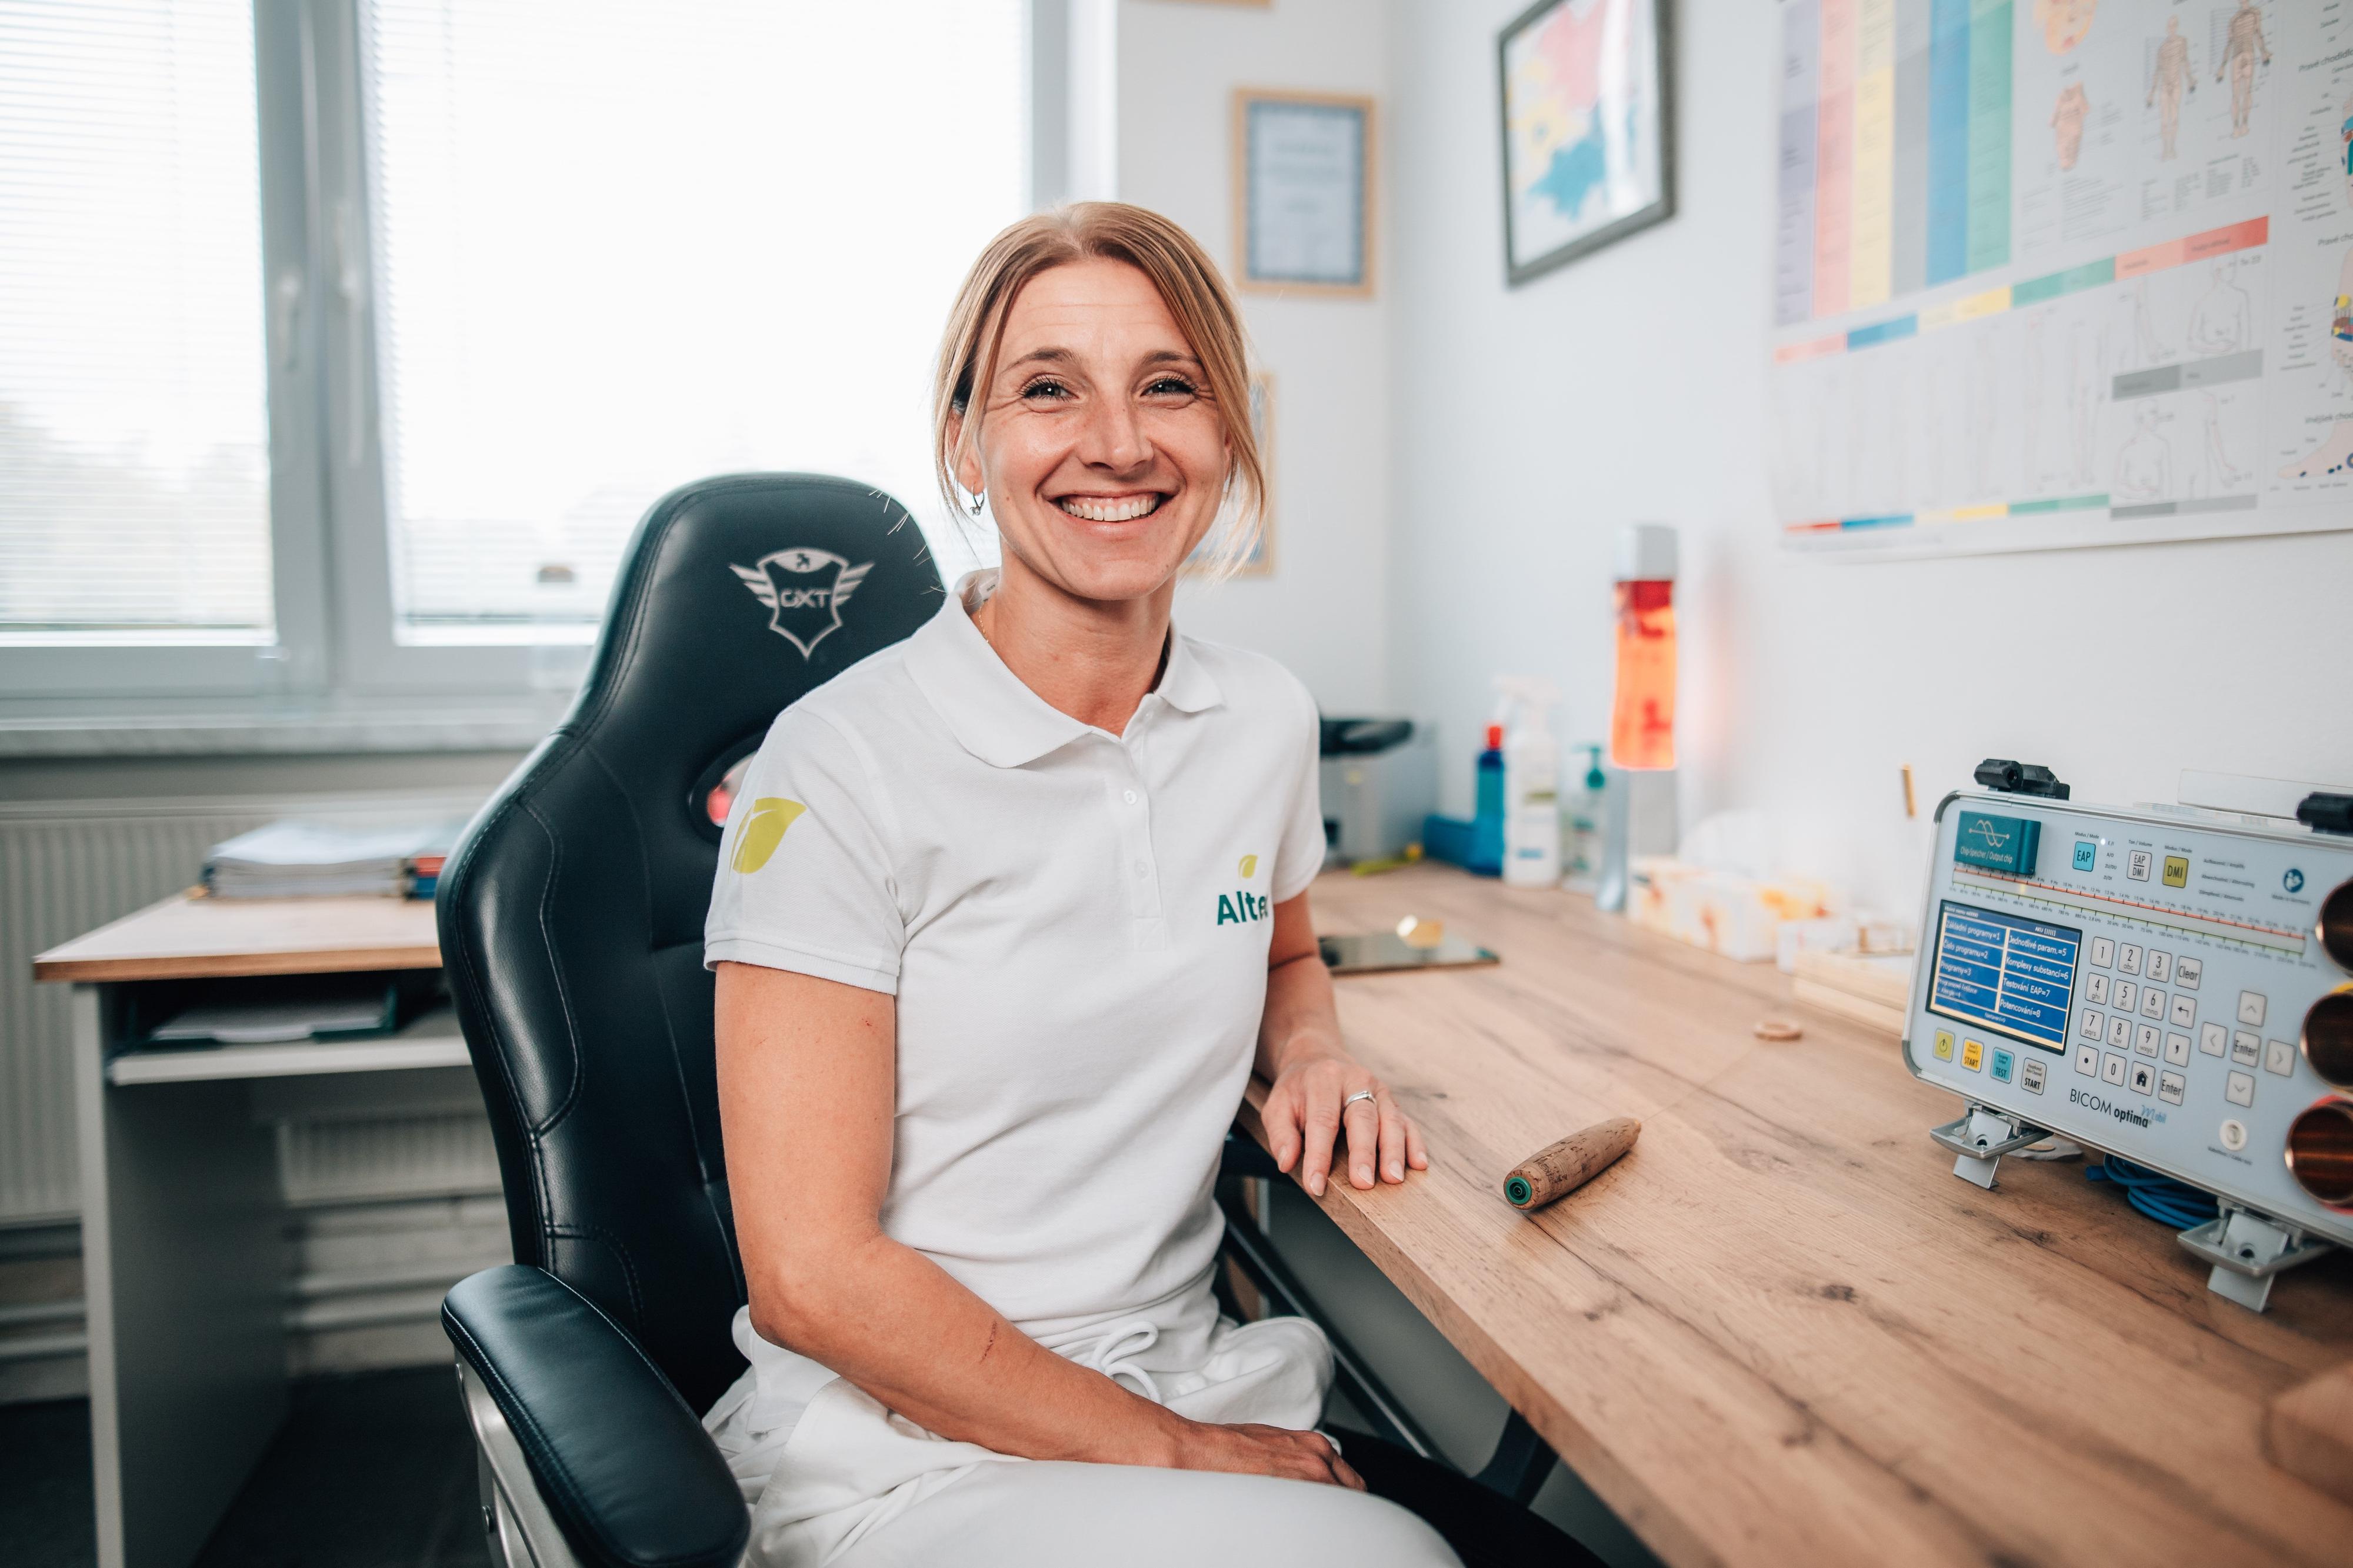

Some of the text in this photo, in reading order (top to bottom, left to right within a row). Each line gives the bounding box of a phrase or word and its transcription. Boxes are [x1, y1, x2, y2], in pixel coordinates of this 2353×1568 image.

[2077, 850, 2091, 863] EAP
[2134, 855, 2145, 864] EAP
[2132, 867, 2144, 878] DMI
[2167, 865, 2184, 879] DMI
[2101, 946, 2104, 959] 1
[2127, 949, 2133, 962] 2
[2006, 956, 2032, 972] Komplexy
[2156, 956, 2162, 969] 3
[2178, 965, 2199, 982] Clear
[2003, 977, 2051, 998] Testování EAP=7
[2095, 979, 2100, 991] 4
[2122, 986, 2128, 998] 5
[2151, 993, 2156, 1006] 6
[2089, 1015, 2095, 1026] 7
[2117, 1023, 2122, 1035] 8
[2145, 1030, 2151, 1043] 9
[1964, 1056, 1979, 1069] START
[1995, 1066, 2007, 1078] TEST
[2111, 1063, 2117, 1076] 0
[2024, 1077, 2041, 1090] START
[2161, 1079, 2182, 1097] Enter
[2069, 1088, 2112, 1116] BICOM
